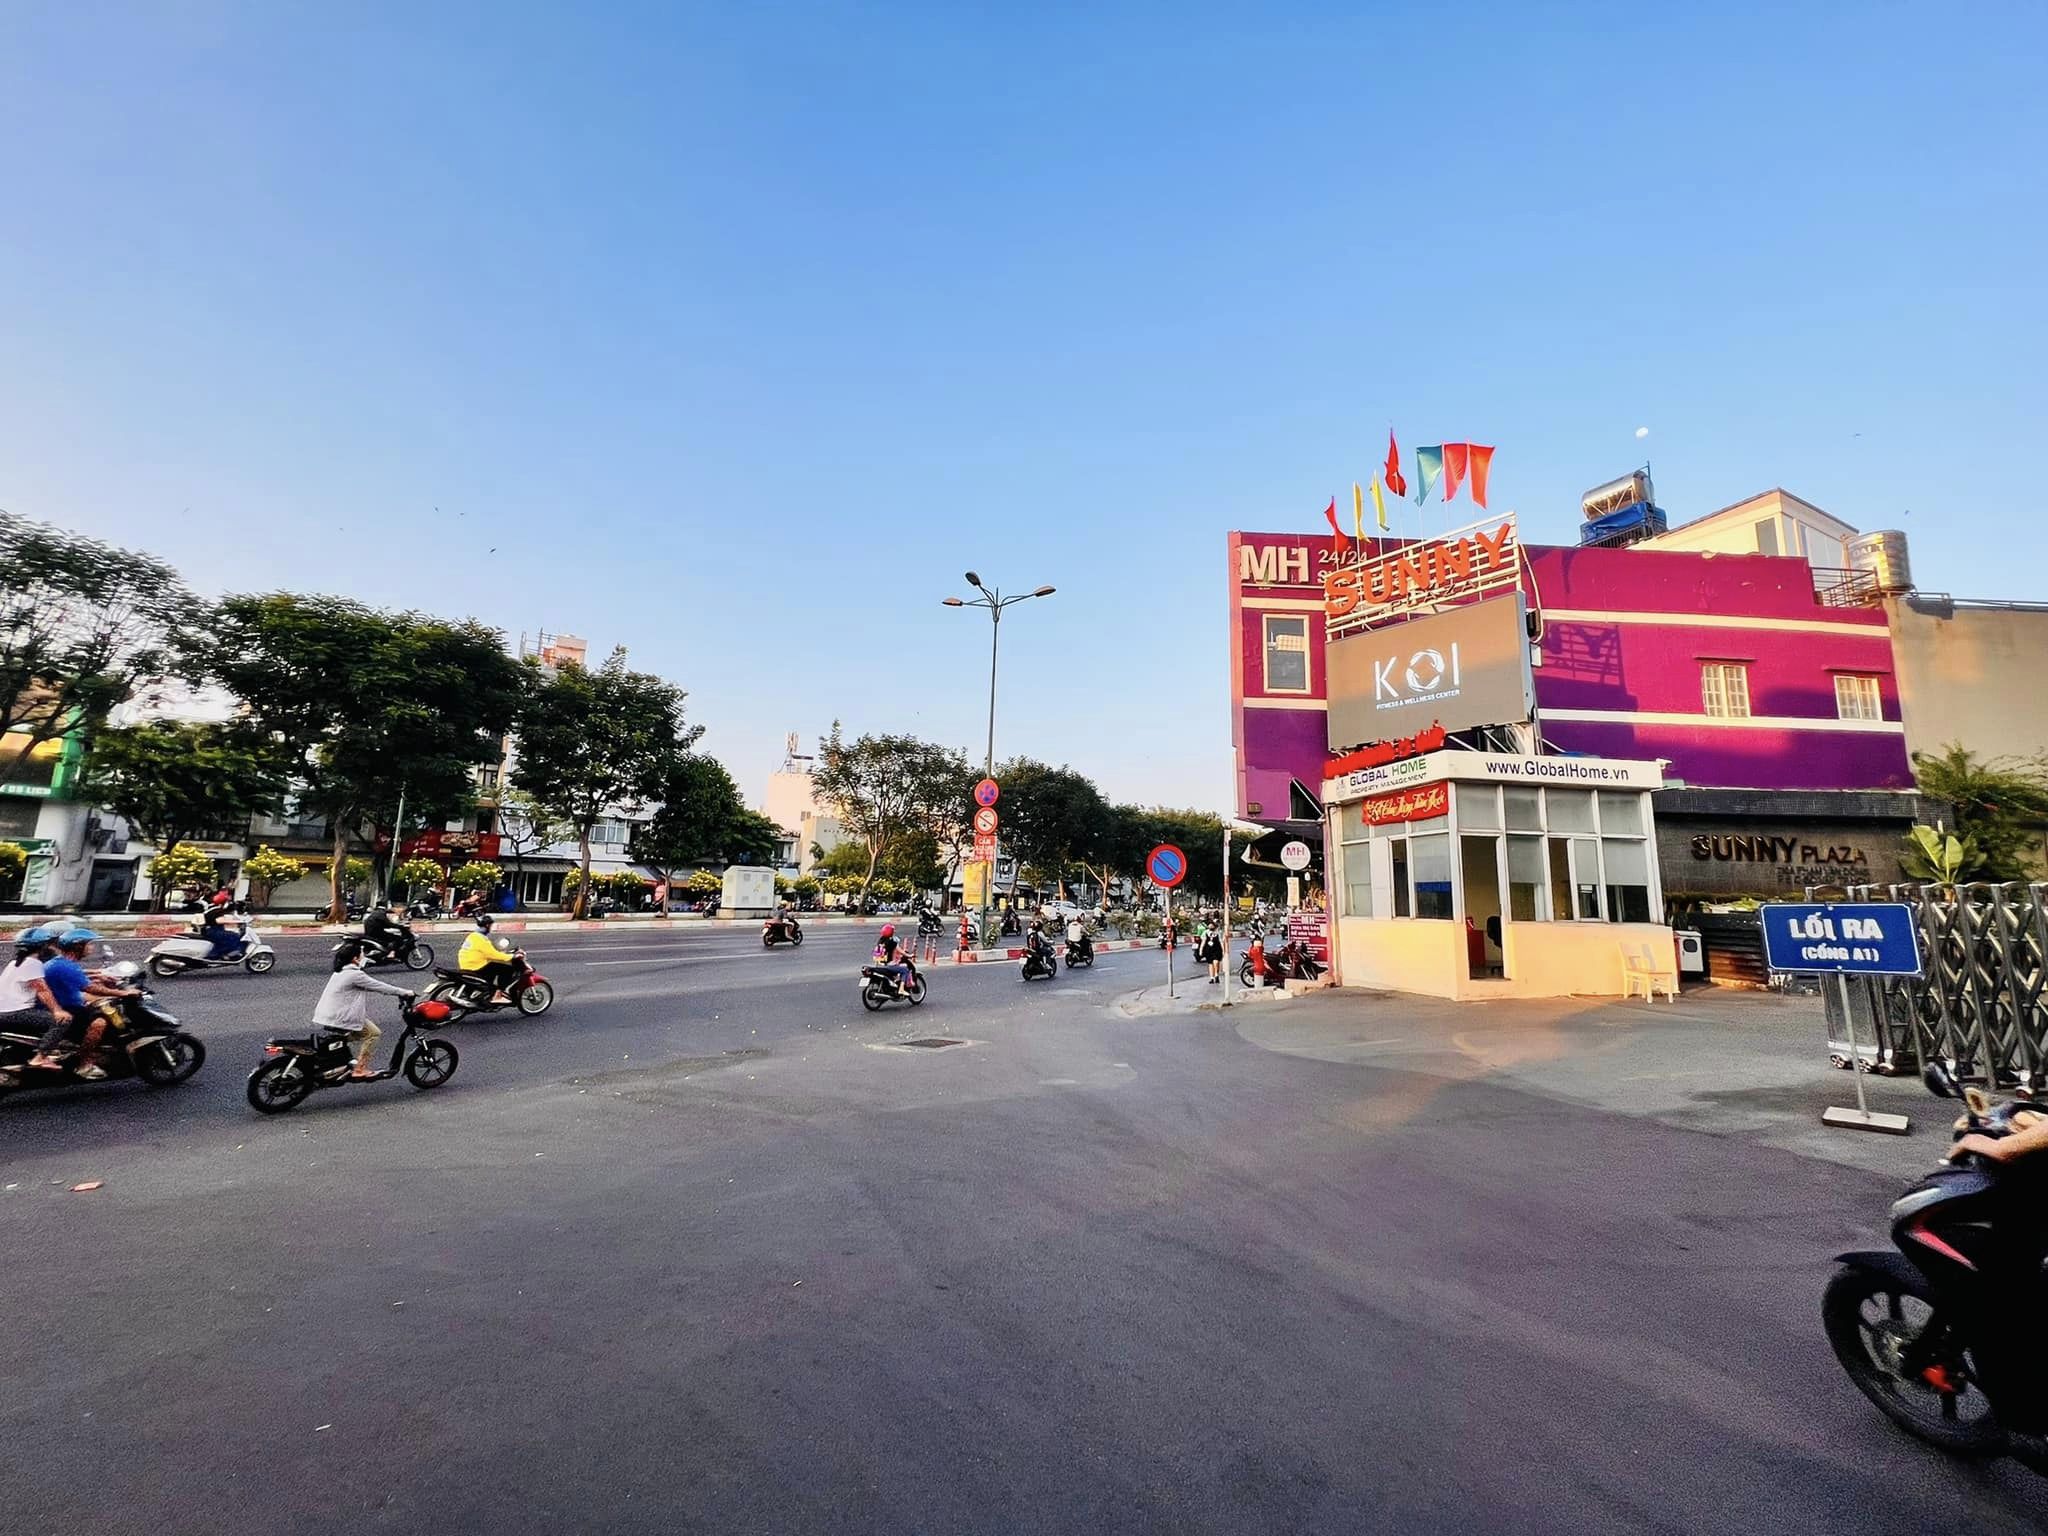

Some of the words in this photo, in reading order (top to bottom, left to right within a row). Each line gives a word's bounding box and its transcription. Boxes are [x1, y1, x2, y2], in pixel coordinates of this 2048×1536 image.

[1241, 545, 1309, 582] MH
[1325, 523, 1510, 615] SUNNY
[1375, 642, 1459, 700] KOI
[1435, 689, 1460, 699] CENTER
[1350, 769, 1388, 786] GLOBAL
[1391, 758, 1427, 776] HOME
[1381, 772, 1427, 788] MANAGEMENT
[1486, 761, 1629, 780] www.GlobalHome.vn
[1691, 834, 1797, 863] SUNNY
[1801, 845, 1868, 864] PLAZA
[1841, 918, 1884, 939] RA
[1853, 948, 1880, 962] A1)
